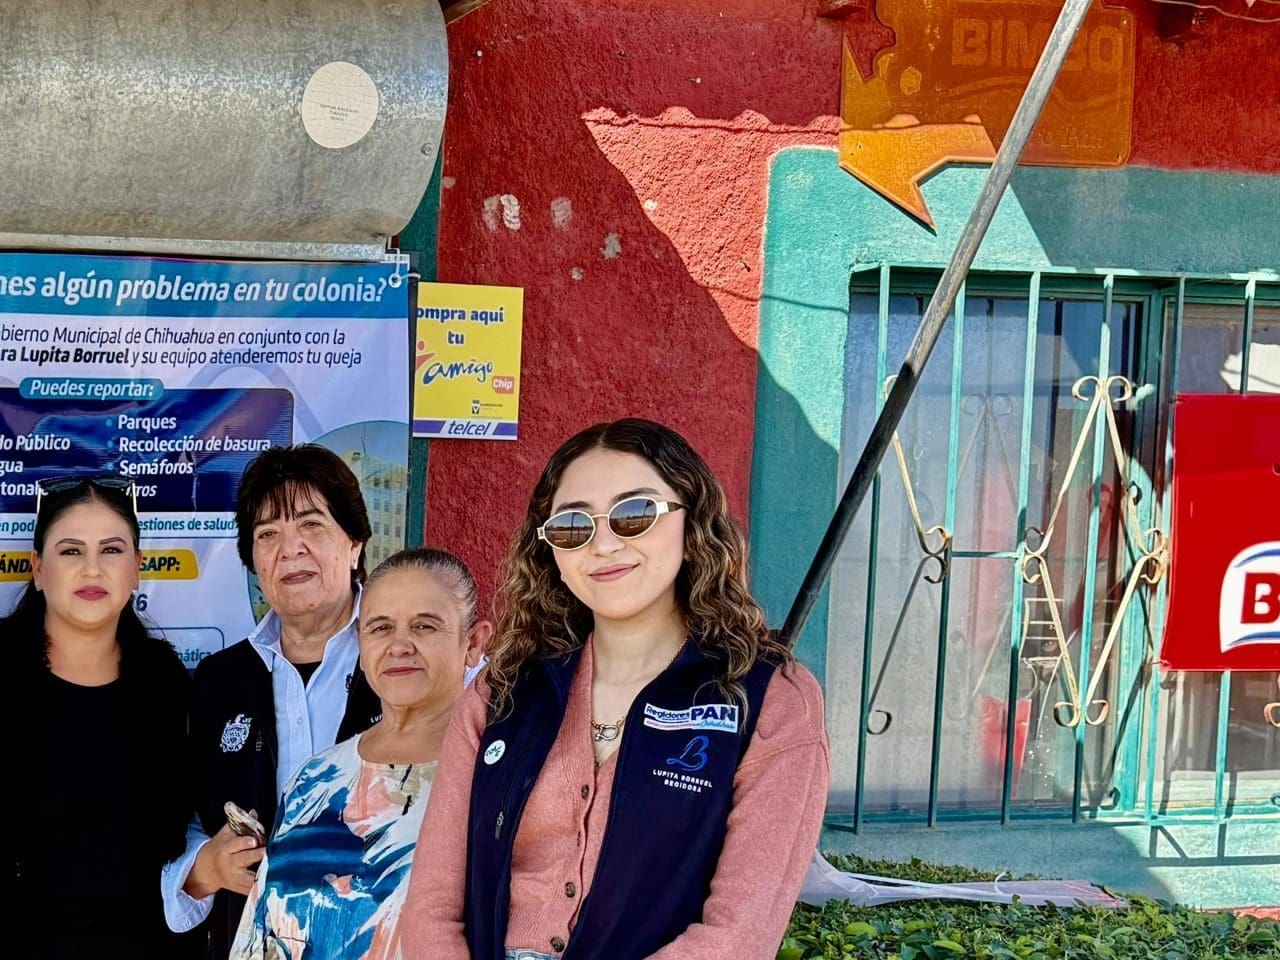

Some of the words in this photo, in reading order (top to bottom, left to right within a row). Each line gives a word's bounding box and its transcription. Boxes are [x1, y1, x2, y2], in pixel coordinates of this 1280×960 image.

[40, 269, 113, 306] algún
[116, 274, 230, 305] problema
[233, 282, 260, 301] en
[265, 277, 290, 301] tu
[292, 276, 387, 304] colonia?
[416, 307, 466, 323] ompra
[53, 326, 122, 348] Municipal
[124, 327, 141, 345] de
[144, 327, 215, 345] Chihuahua
[218, 332, 235, 345] en
[238, 328, 301, 349] conjunto
[305, 332, 329, 345] con
[333, 329, 345, 345] la
[447, 331, 465, 345] tu
[20, 346, 70, 366] Lupita
[73, 347, 129, 365] Borruel
[130, 353, 140, 368] y
[141, 351, 157, 364] su
[160, 350, 207, 368] equipo
[210, 348, 303, 365] atenderemos
[307, 350, 321, 364] tu
[324, 350, 362, 368] queja
[423, 359, 493, 384] amigo
[30, 379, 85, 396] Puedes
[87, 381, 154, 400] reportar:
[493, 378, 513, 391] Chip
[118, 415, 177, 433] Parques
[447, 420, 491, 436] telcel
[16, 433, 70, 451] Público
[119, 435, 204, 452] Recolección
[205, 436, 221, 451] de
[224, 436, 271, 452] basura
[120, 459, 194, 475] Semáforos
[11, 519, 35, 534] pod
[138, 517, 185, 530] estiones
[187, 518, 201, 530] de
[138, 556, 181, 572] SAPP:
[691, 706, 736, 721] PAN
[652, 769, 679, 780] LUPITA
